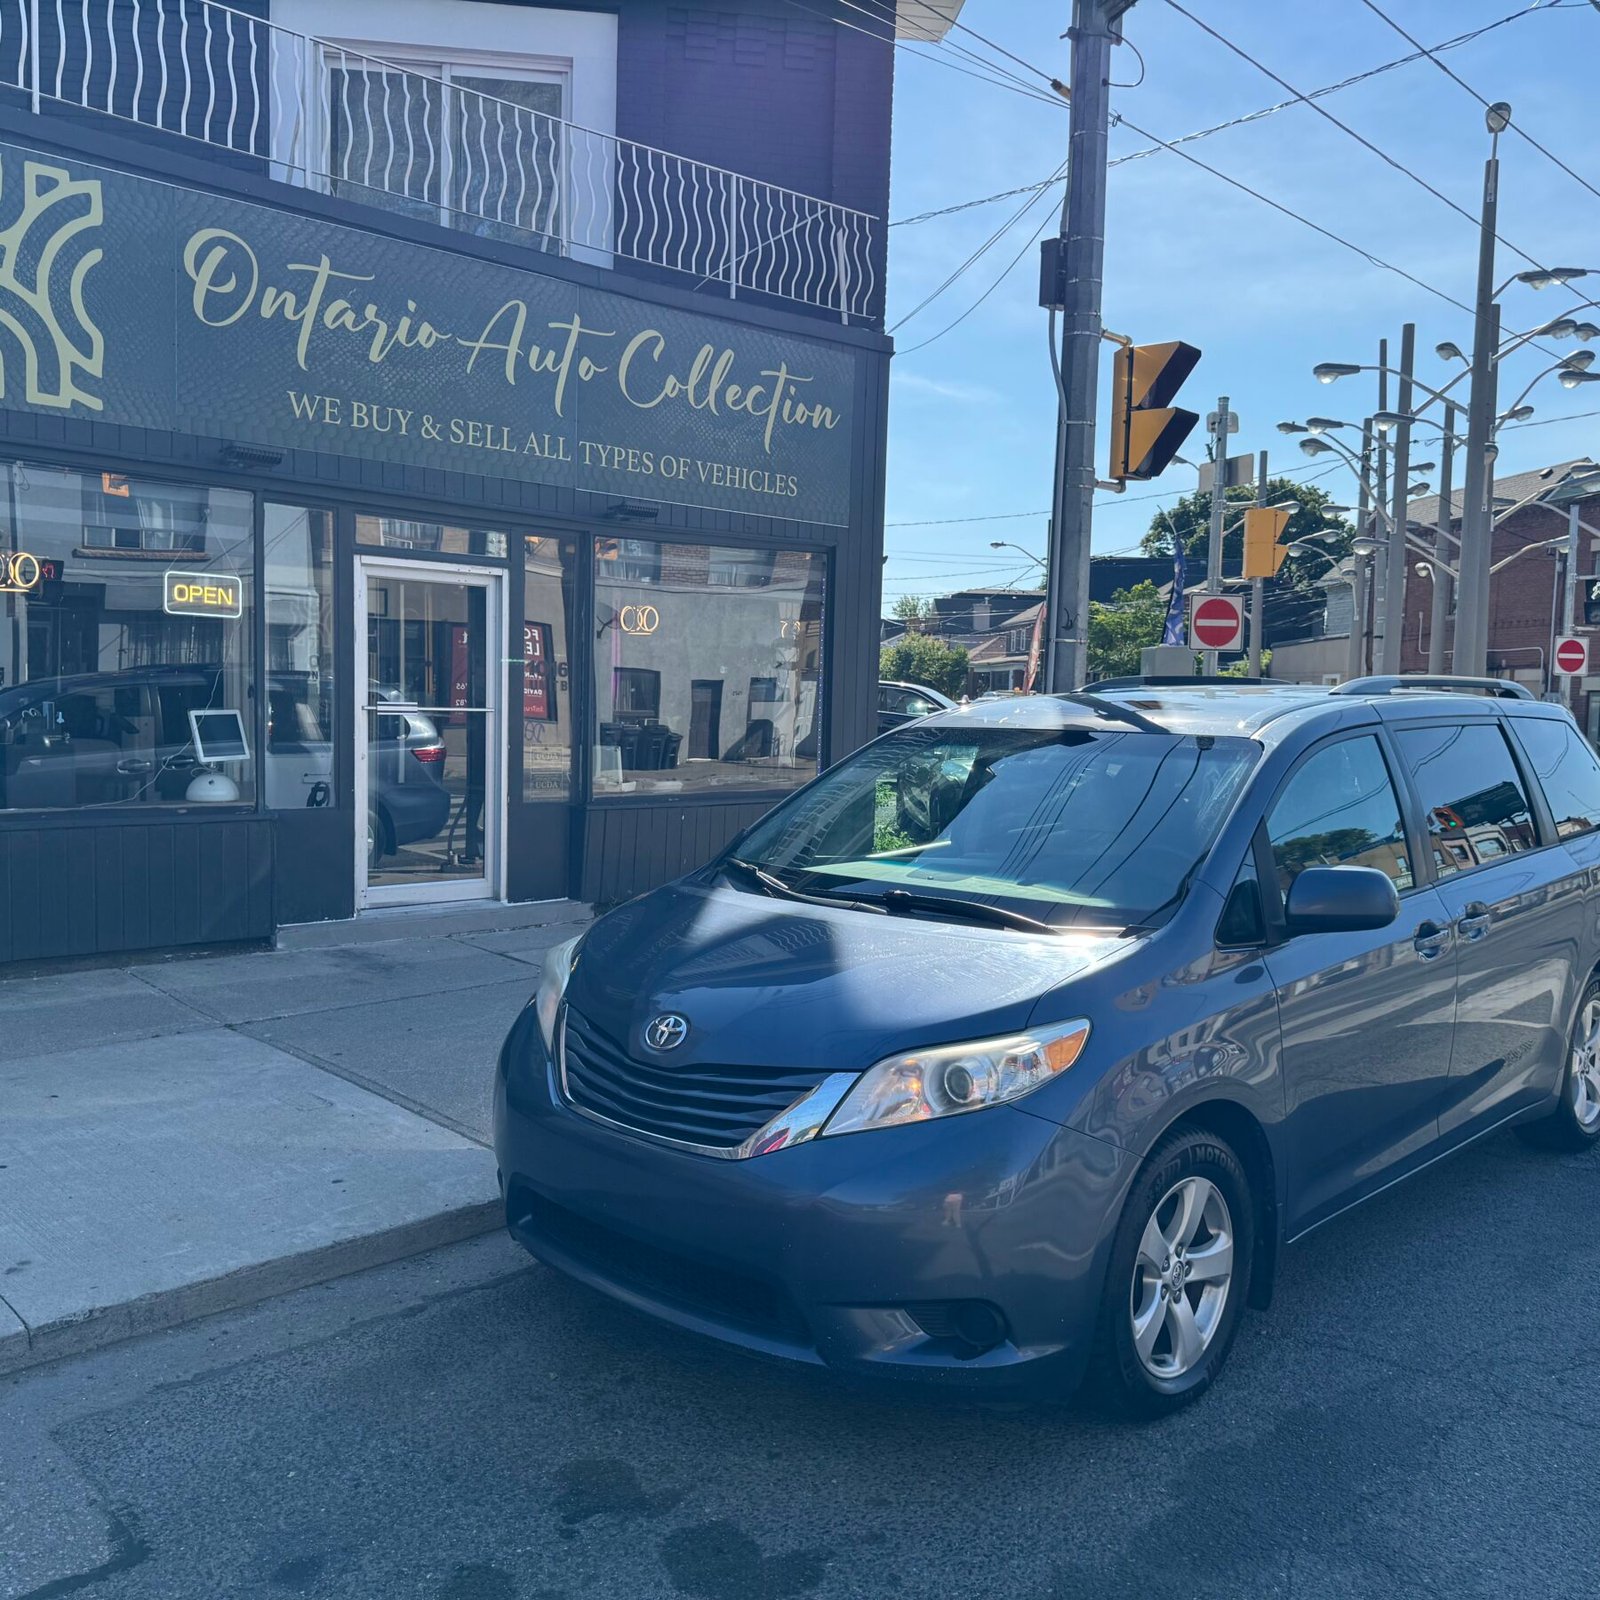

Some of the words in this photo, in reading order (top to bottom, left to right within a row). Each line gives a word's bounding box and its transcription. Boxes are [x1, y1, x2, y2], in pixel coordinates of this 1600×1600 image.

[183, 228, 452, 371] Ontario
[456, 299, 616, 417] Auto
[619, 329, 841, 454] Collection
[287, 391, 342, 425] WE
[351, 401, 414, 436] BUY
[421, 414, 443, 441] &
[449, 418, 517, 453] SELL
[522, 431, 572, 462] ALL
[578, 441, 654, 475] TYPES
[660, 455, 691, 480] OF
[696, 460, 798, 497] VEHICLES
[173, 584, 233, 606] OPEN
